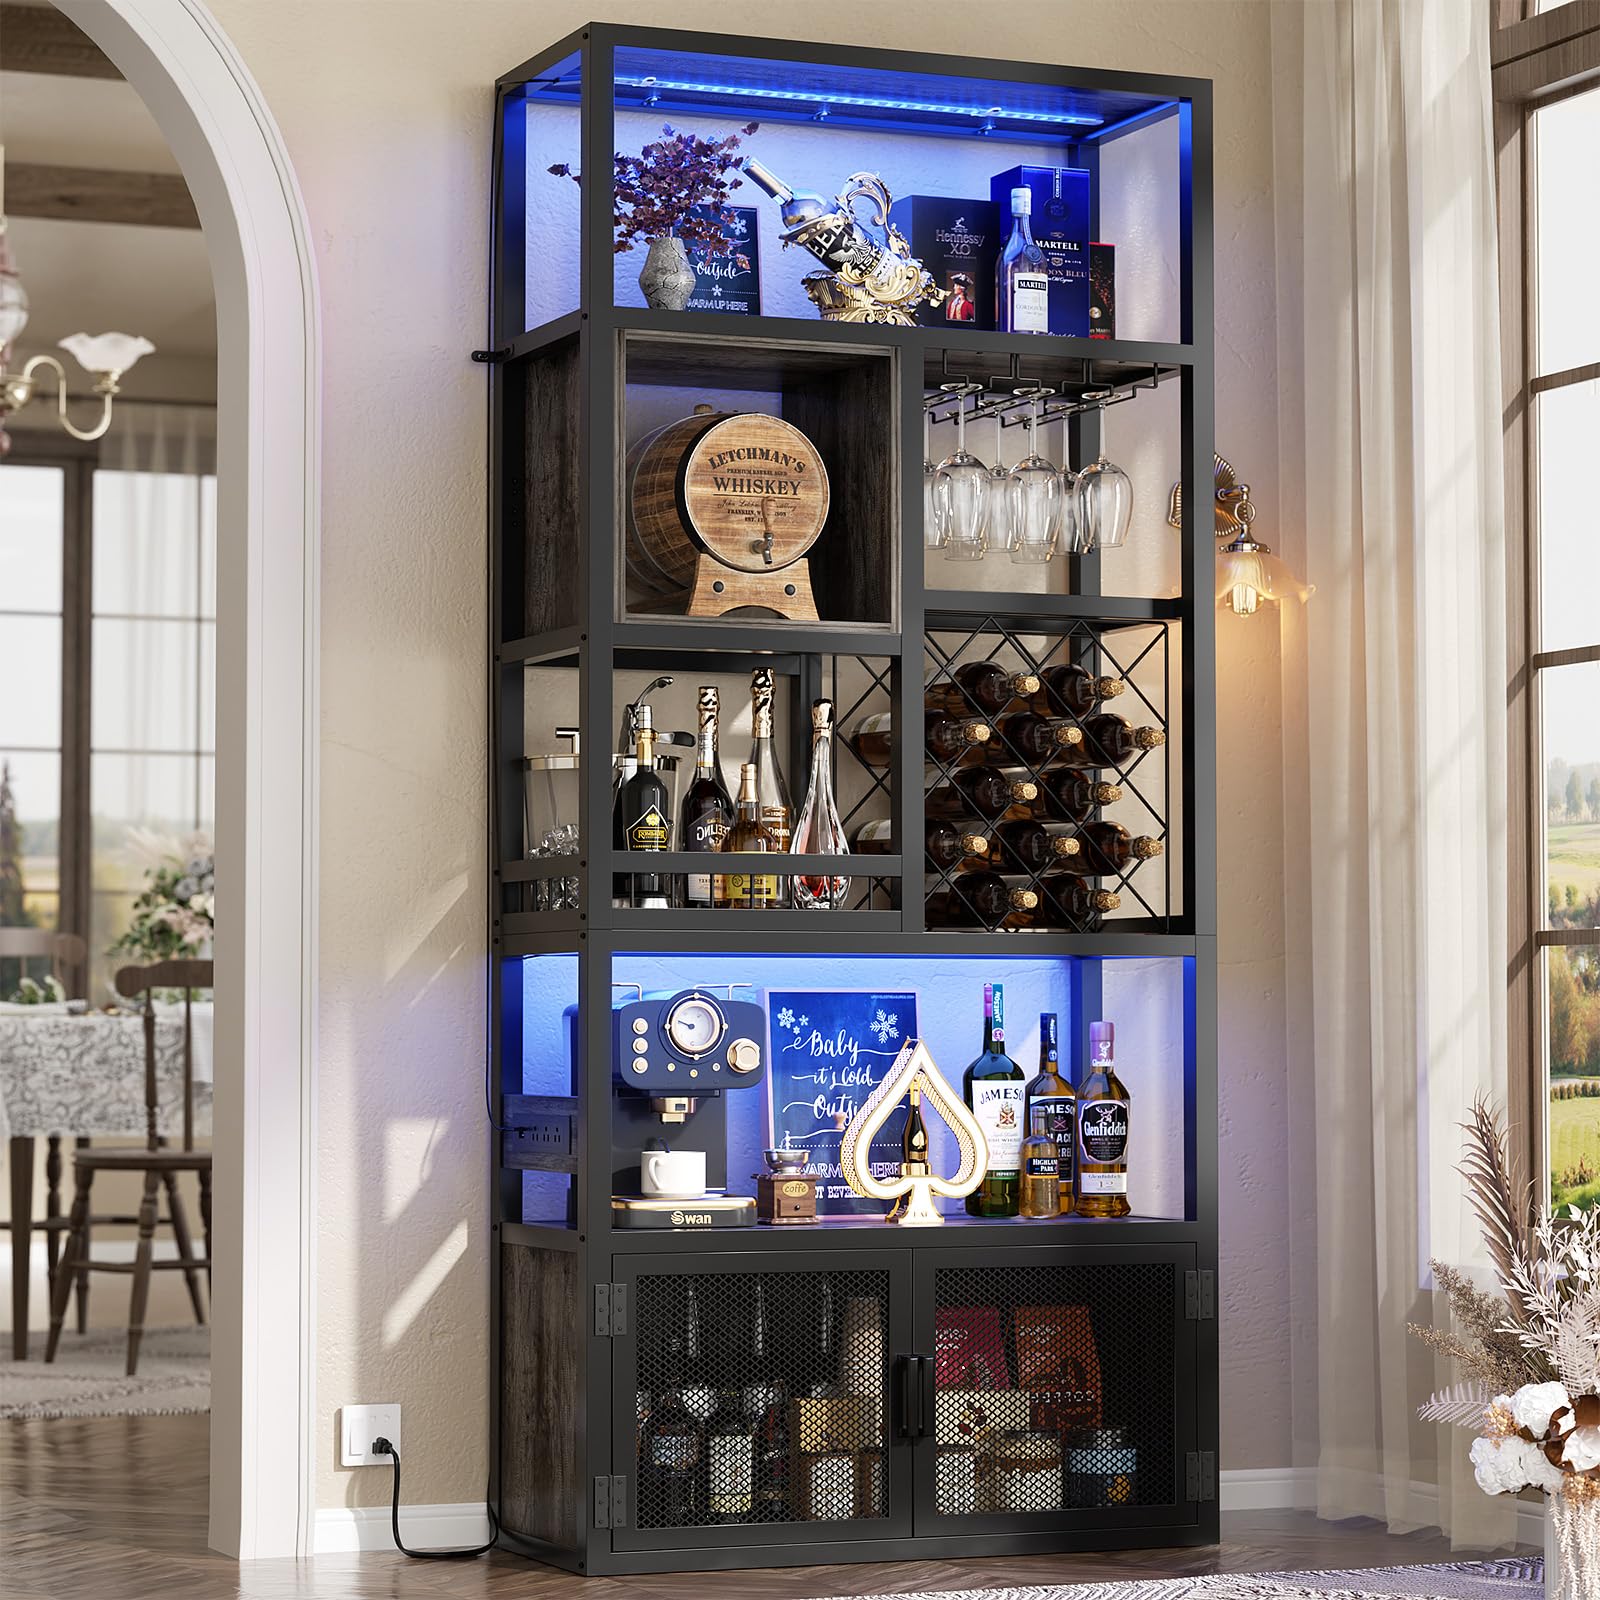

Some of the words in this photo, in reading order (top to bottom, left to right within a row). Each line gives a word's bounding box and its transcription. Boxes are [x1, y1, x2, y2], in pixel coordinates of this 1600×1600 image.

[935, 229, 985, 247] Hennessy
[1035, 240, 1079, 251] MARTELL
[697, 261, 741, 280] Outside
[708, 447, 806, 474] LETCHMAN'S
[712, 476, 801, 496] WHISKEY
[993, 991, 1002, 1023] JAMESON
[794, 1029, 860, 1066] Baby
[812, 1066, 838, 1090] it's
[841, 1064, 875, 1087] Cold
[1083, 1121, 1127, 1137] Glenfiddich
[784, 1183, 806, 1192] coffe
[670, 1210, 712, 1225] Swan
